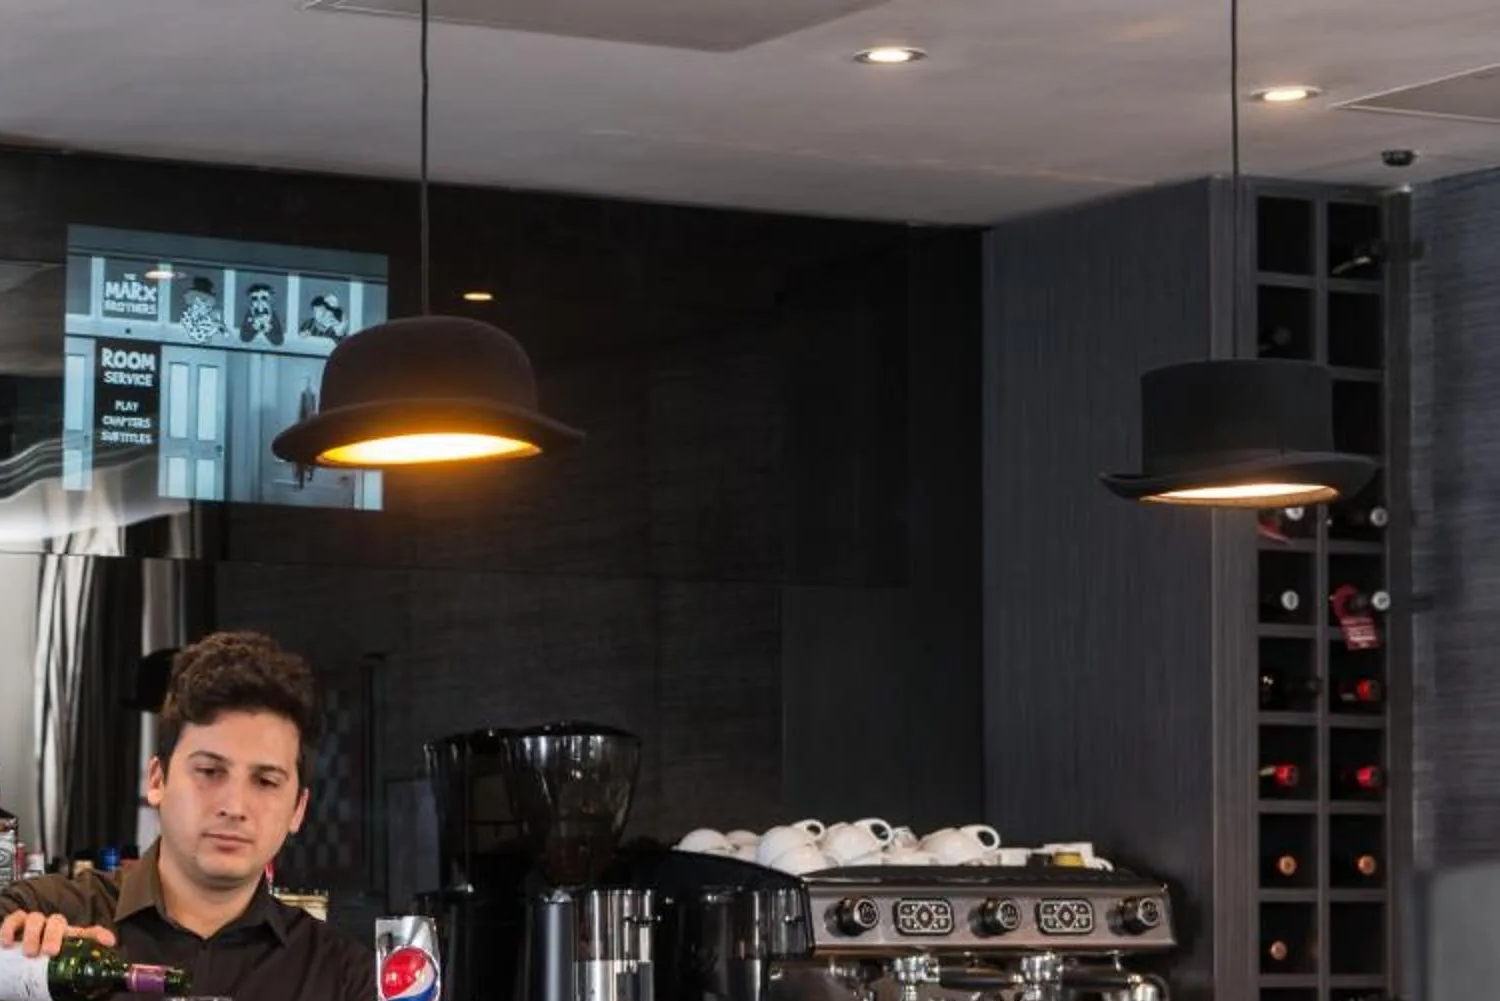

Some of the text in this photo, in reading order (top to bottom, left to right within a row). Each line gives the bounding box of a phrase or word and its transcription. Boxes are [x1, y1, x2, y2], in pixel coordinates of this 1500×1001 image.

[105, 281, 156, 301] MARX
[101, 347, 156, 371] ROOM
[103, 371, 153, 387] SERVICE
[115, 400, 139, 412] PLAY
